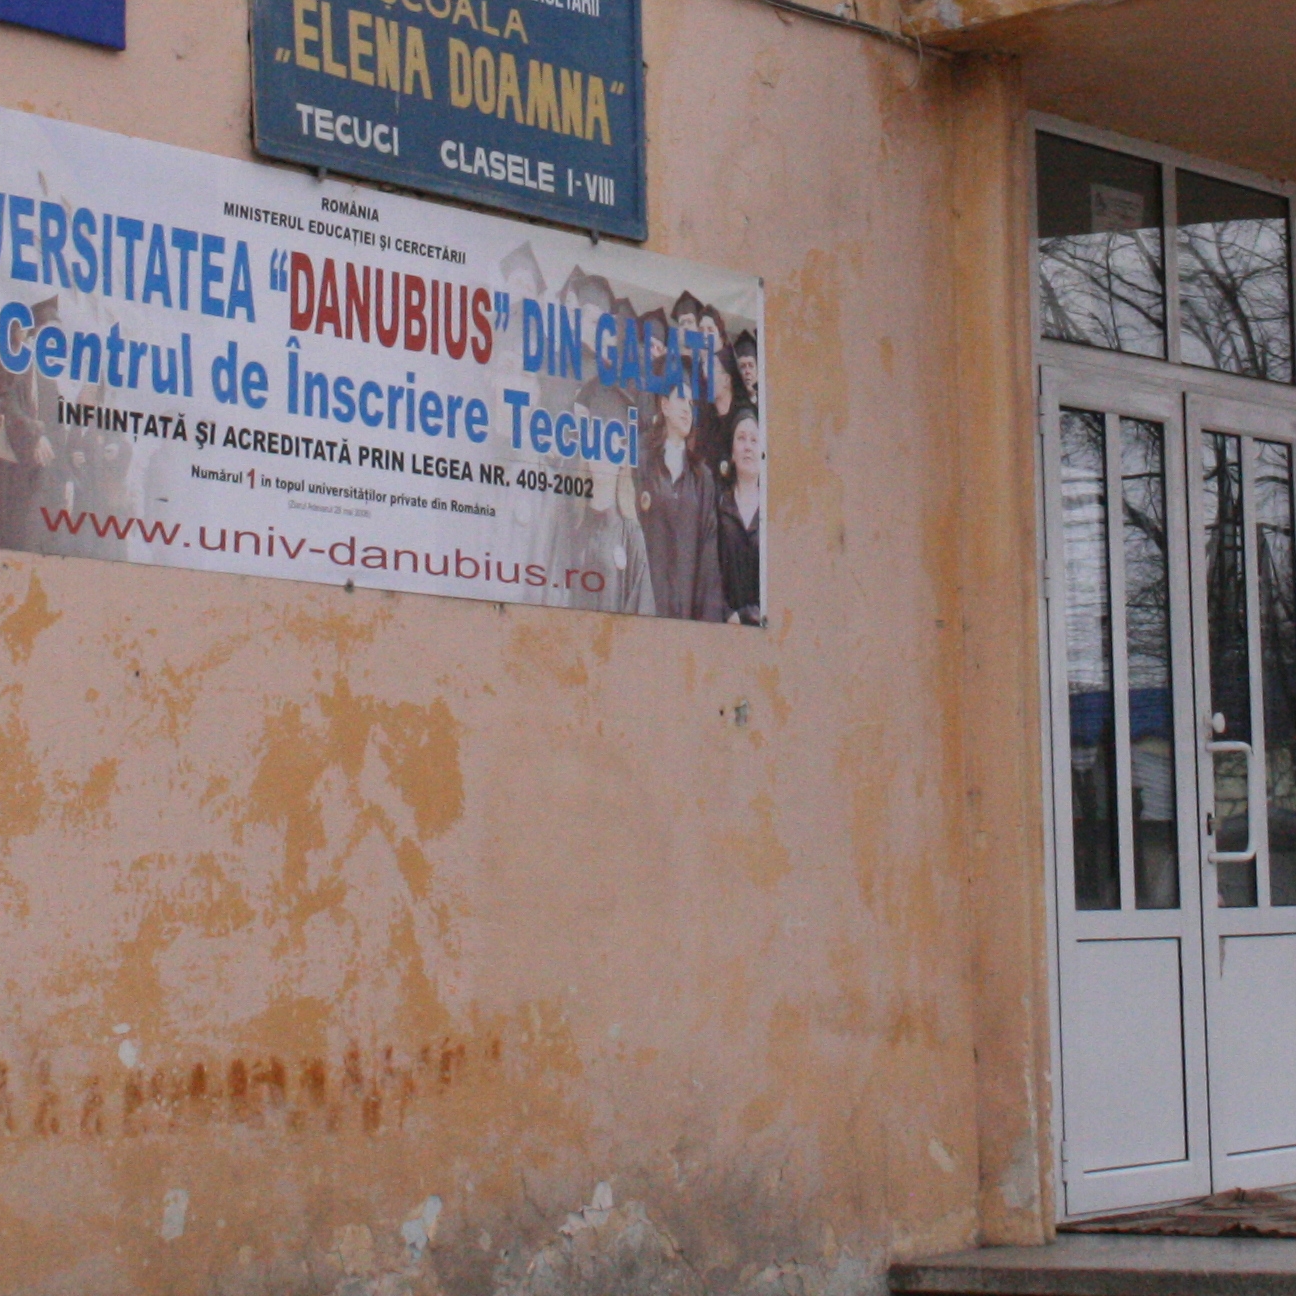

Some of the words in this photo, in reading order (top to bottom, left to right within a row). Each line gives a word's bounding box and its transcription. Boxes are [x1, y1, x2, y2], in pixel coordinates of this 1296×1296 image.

[296, 103, 399, 155] TECUCI
[441, 140, 554, 192] CLASELE
[568, 169, 614, 206] I-VIII
[224, 202, 304, 231] MINISTERUL
[321, 197, 380, 222] ROMÂNIA
[270, 248, 509, 364] “DANUBIUS”
[522, 298, 582, 381] DIN
[212, 341, 269, 410] de
[287, 336, 489, 443] Înscriere
[504, 389, 638, 467] Tecuci
[191, 465, 242, 484] Numărul
[247, 468, 255, 489] 1
[276, 478, 304, 493] topul
[390, 493, 427, 508] private
[431, 497, 447, 510] din
[451, 500, 495, 517] România
[223, 426, 351, 465] ACREDITATĂ
[358, 446, 404, 472] PRIN
[412, 454, 473, 481] LEGEA
[480, 464, 510, 486] NR.
[516, 469, 594, 498] 409-2002
[40, 506, 604, 593] www.univ-danubius.ro
